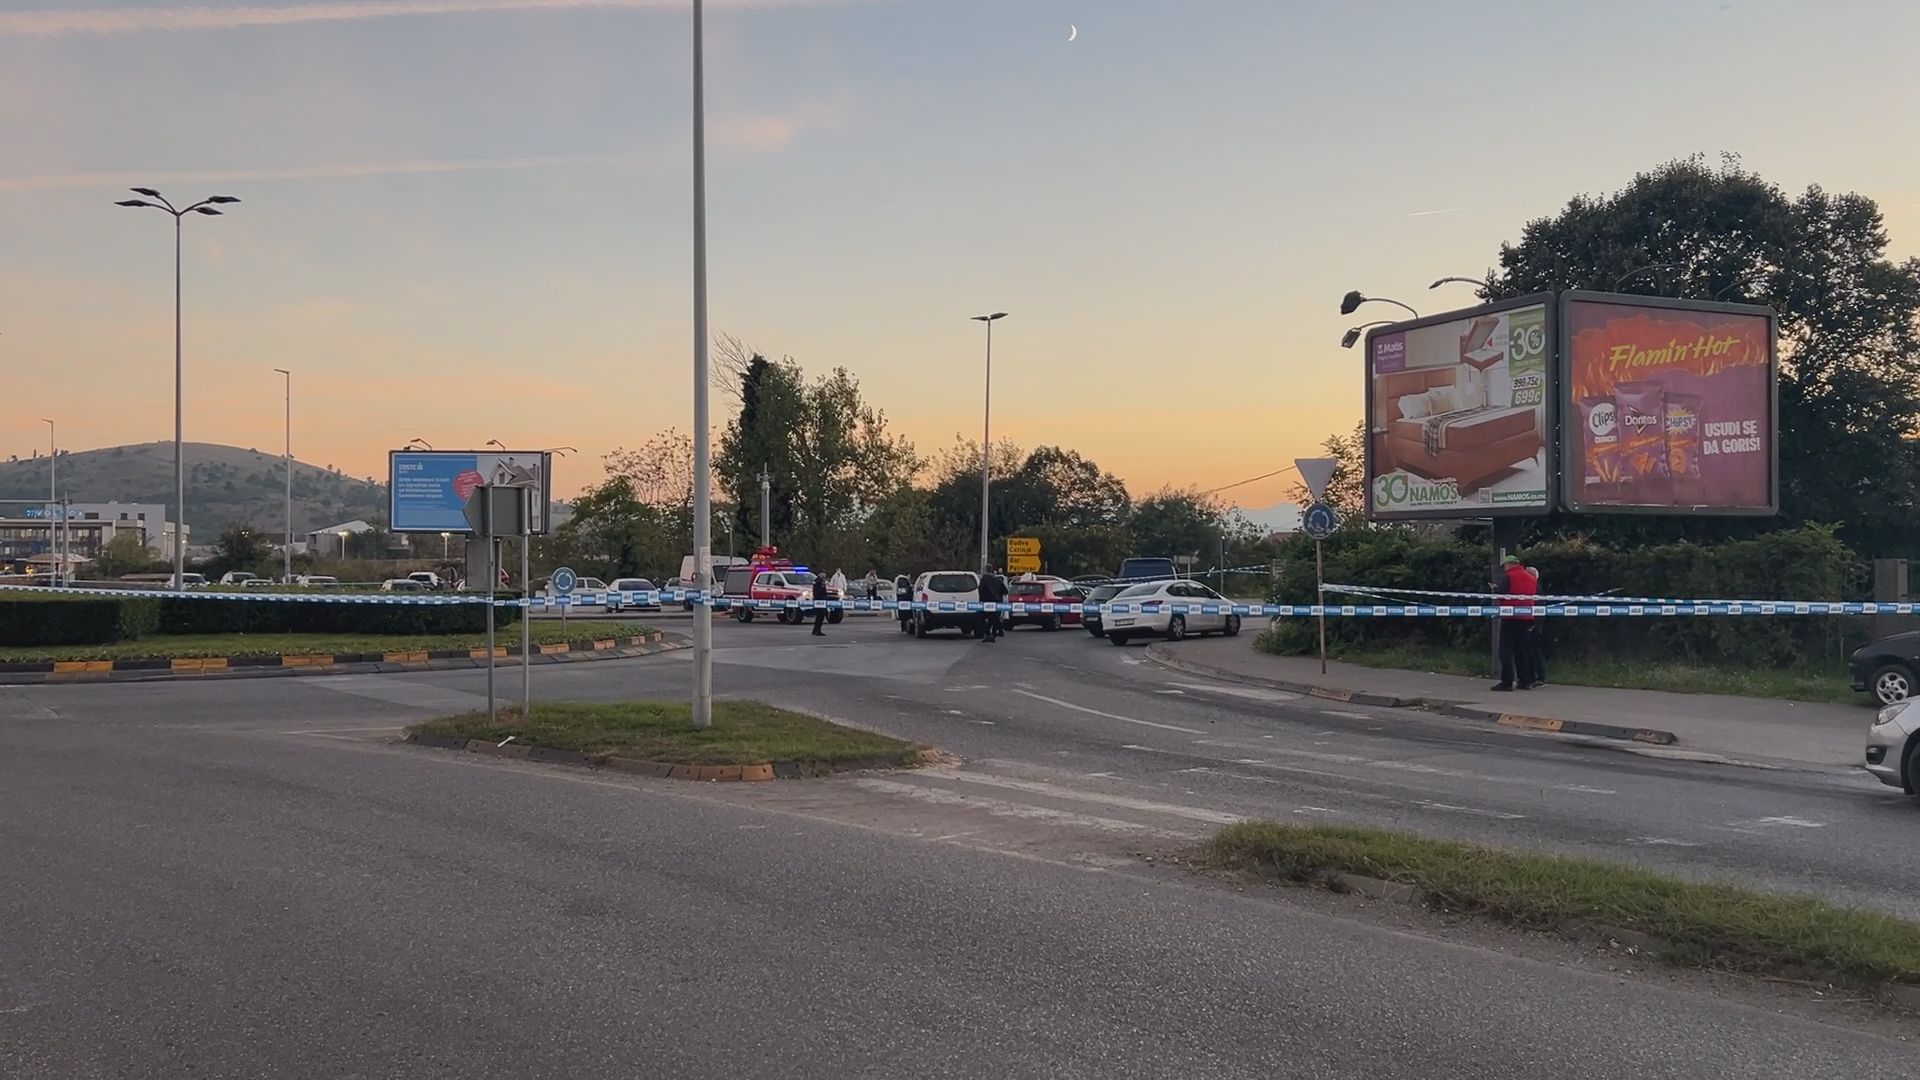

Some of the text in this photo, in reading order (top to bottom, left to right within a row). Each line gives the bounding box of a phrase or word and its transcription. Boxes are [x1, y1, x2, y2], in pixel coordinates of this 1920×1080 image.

[1693, 335, 1740, 359] Hot
[1625, 415, 1657, 426] Doritos
[1742, 420, 1757, 435] SE
[1703, 440, 1719, 455] DA
[1410, 484, 1458, 501] NAMOS
